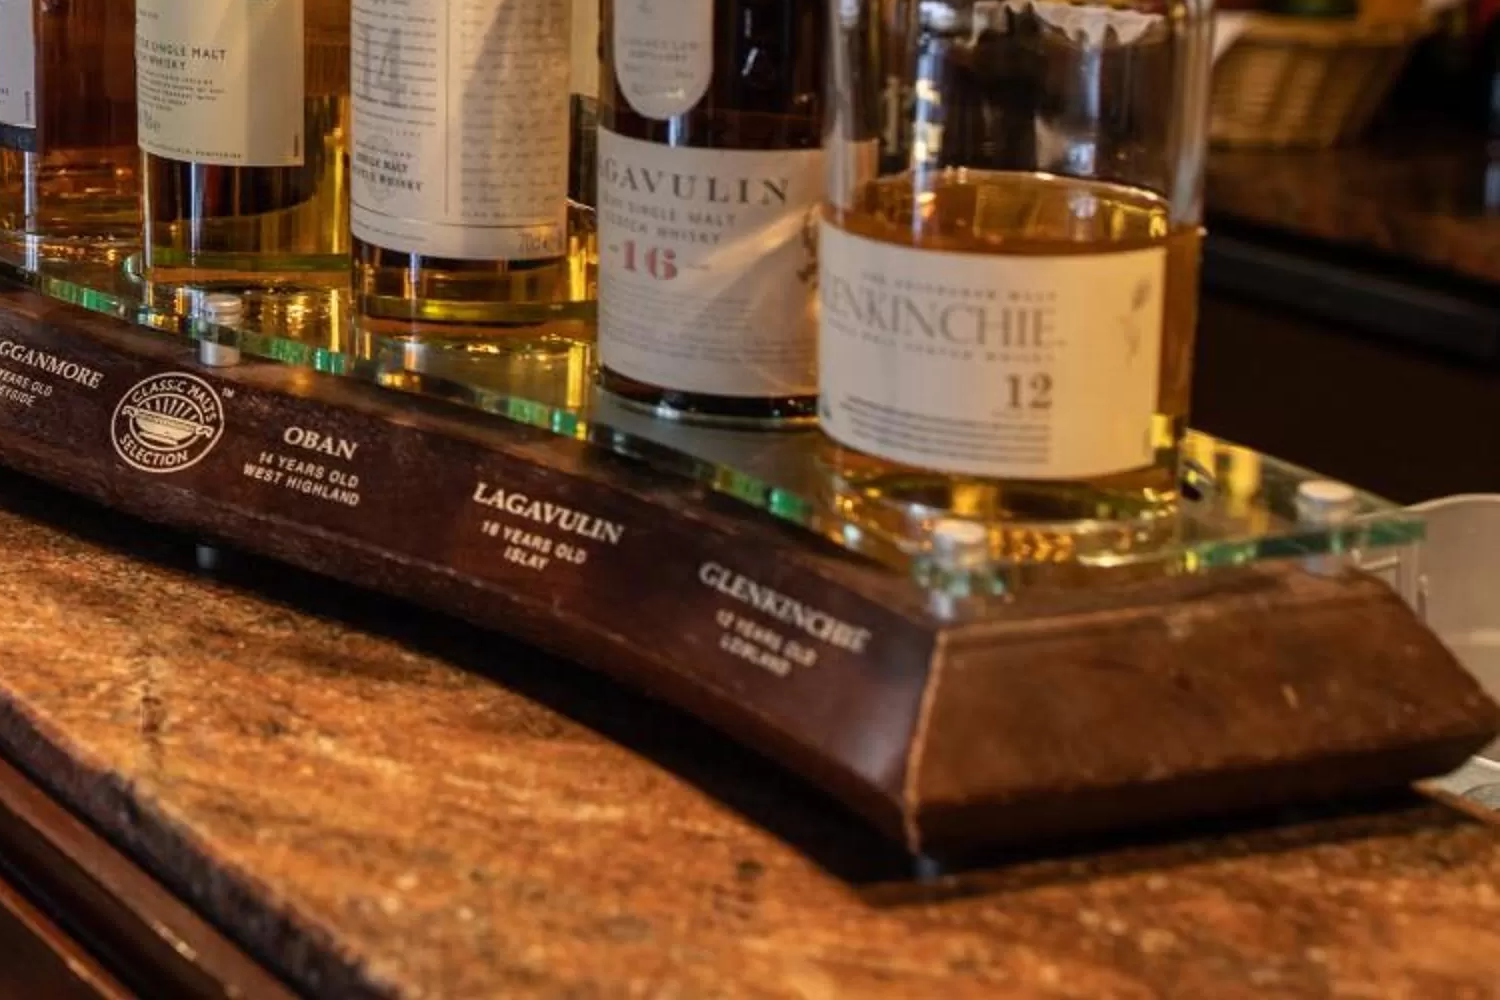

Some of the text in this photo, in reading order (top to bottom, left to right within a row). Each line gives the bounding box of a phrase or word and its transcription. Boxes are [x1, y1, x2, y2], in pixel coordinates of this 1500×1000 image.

[192, 46, 228, 61] MALT
[623, 239, 679, 282] 16
[31, 381, 53, 397] OLD
[131, 379, 218, 423] CLASSIC MALTS
[1005, 372, 1054, 410] 12
[119, 433, 189, 466] SELECTION
[283, 426, 359, 460] OBAN
[243, 461, 361, 508] WEST HIGHLAND
[259, 450, 360, 489] 14 YEARS OLD
[472, 480, 626, 546] LAGAVULIN
[502, 525, 553, 554] YEARS
[554, 542, 588, 566] OLD
[503, 545, 551, 571] ISLAY
[699, 560, 873, 654] GLENKINCHIE
